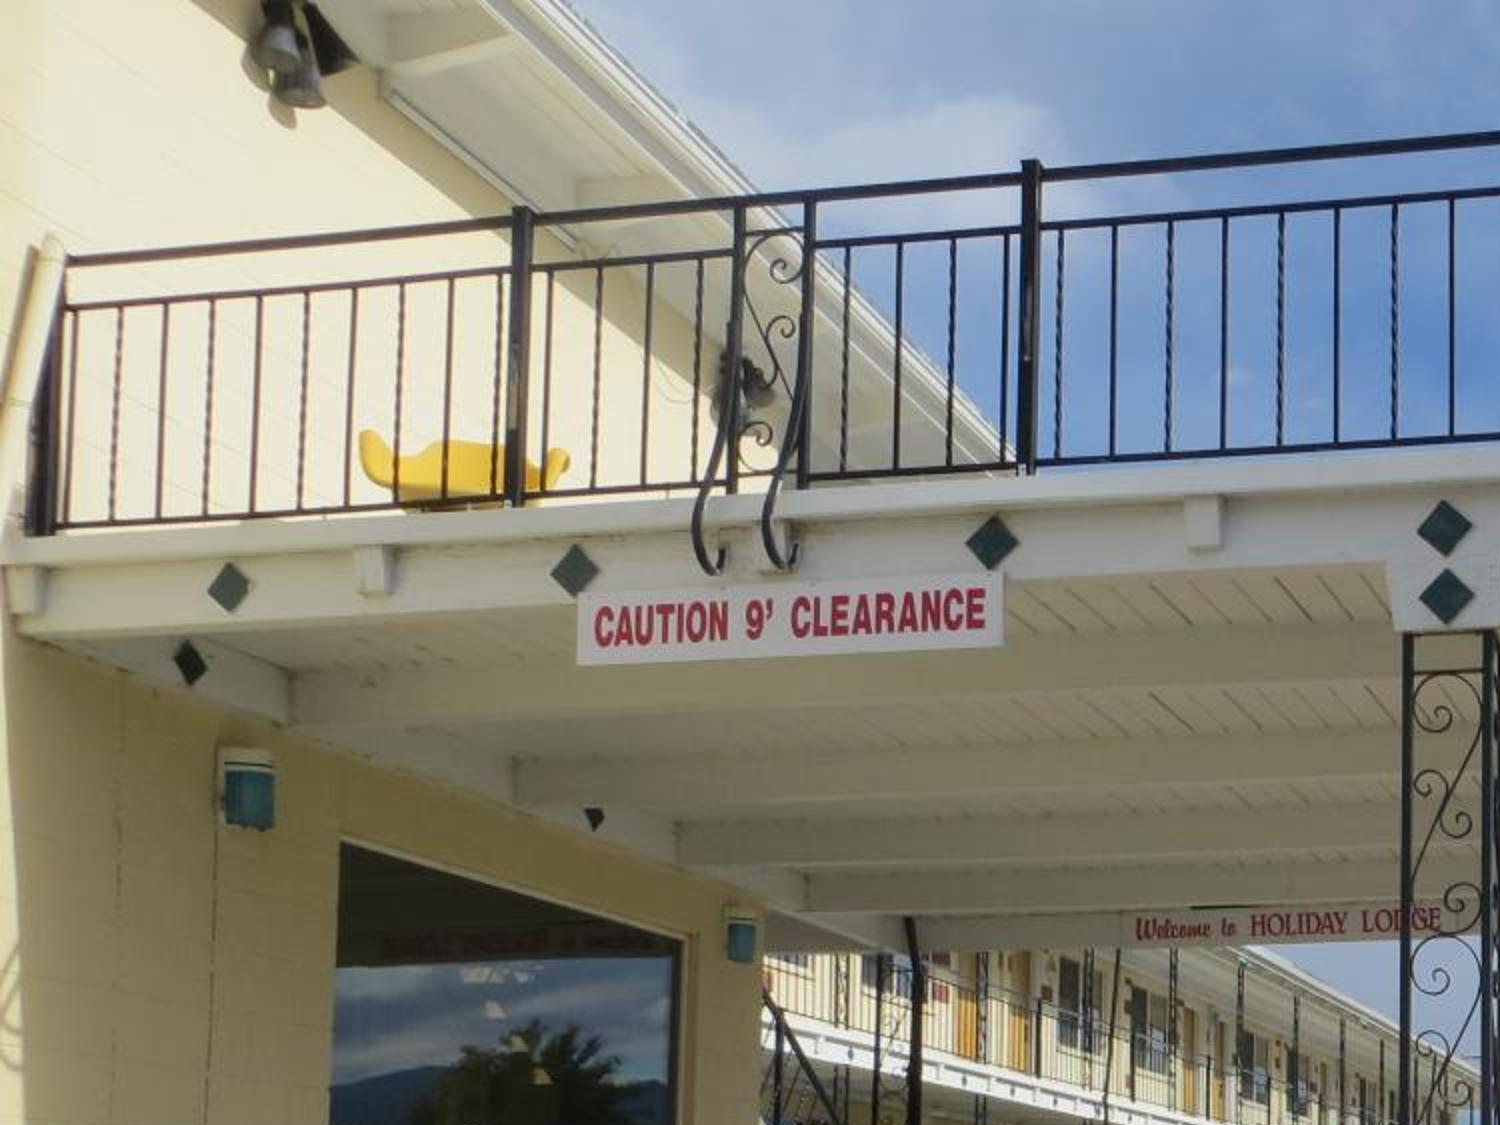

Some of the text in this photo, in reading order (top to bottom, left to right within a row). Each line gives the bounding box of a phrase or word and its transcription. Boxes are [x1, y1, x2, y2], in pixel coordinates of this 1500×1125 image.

[595, 588, 986, 648] CAUTION 9' CLEARANCE
[1136, 916, 1211, 941] Welcome
[1221, 916, 1237, 937] to
[1250, 911, 1348, 937] HOLIDAY
